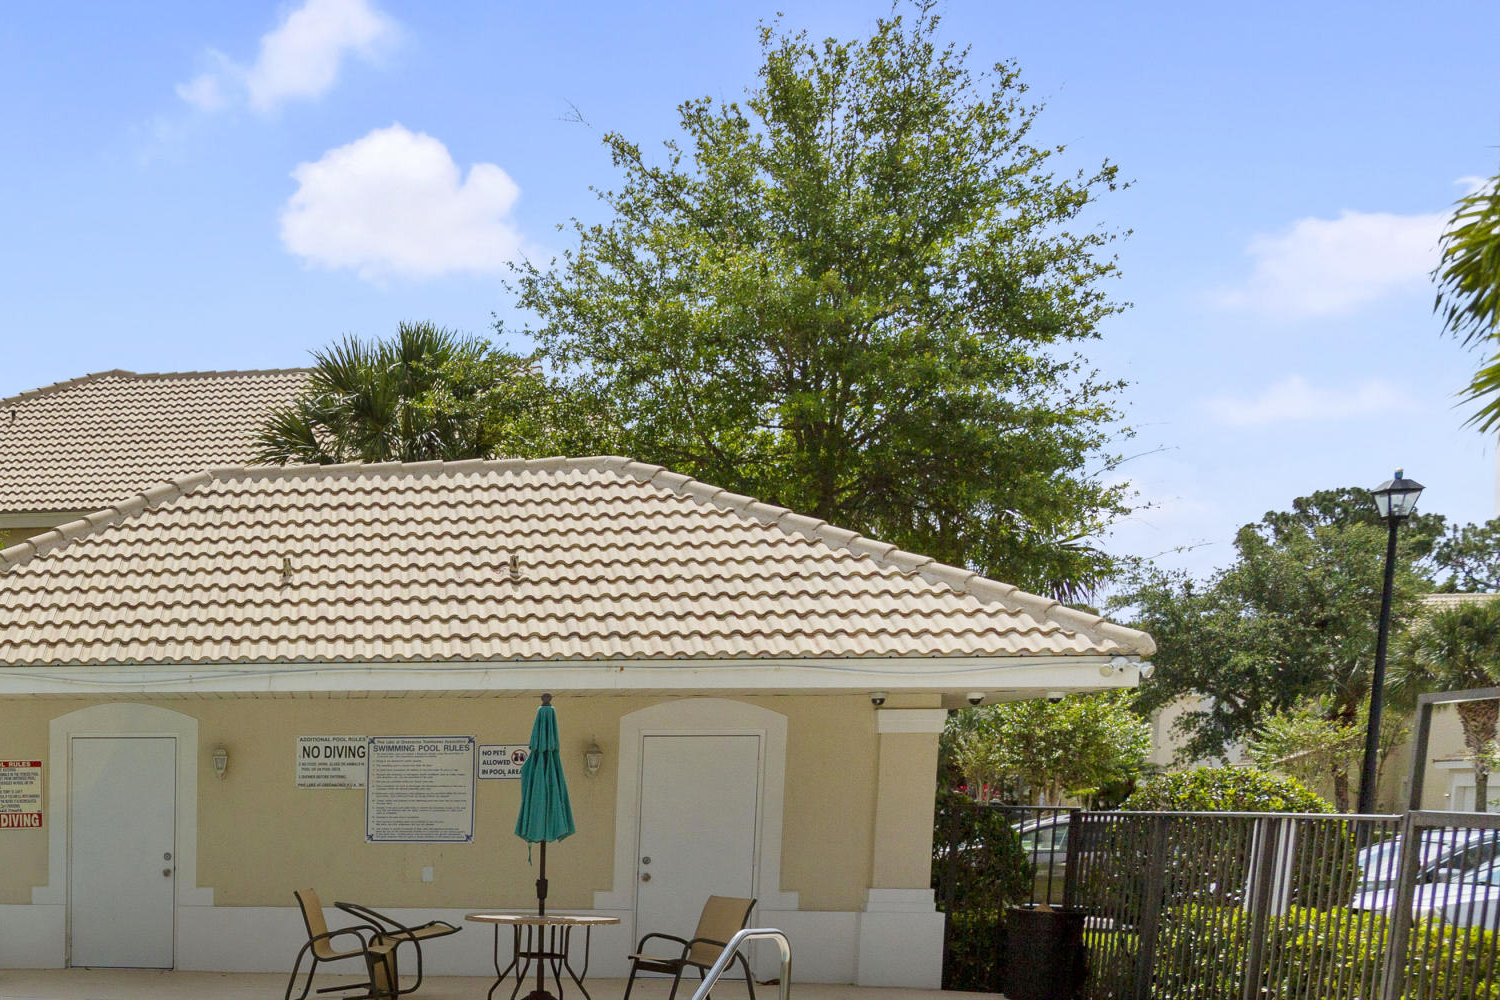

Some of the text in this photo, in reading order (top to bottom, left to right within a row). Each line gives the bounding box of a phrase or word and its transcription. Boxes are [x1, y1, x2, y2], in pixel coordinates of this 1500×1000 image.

[302, 745, 366, 759] NO DIVING
[0, 814, 40, 827] DIVING
